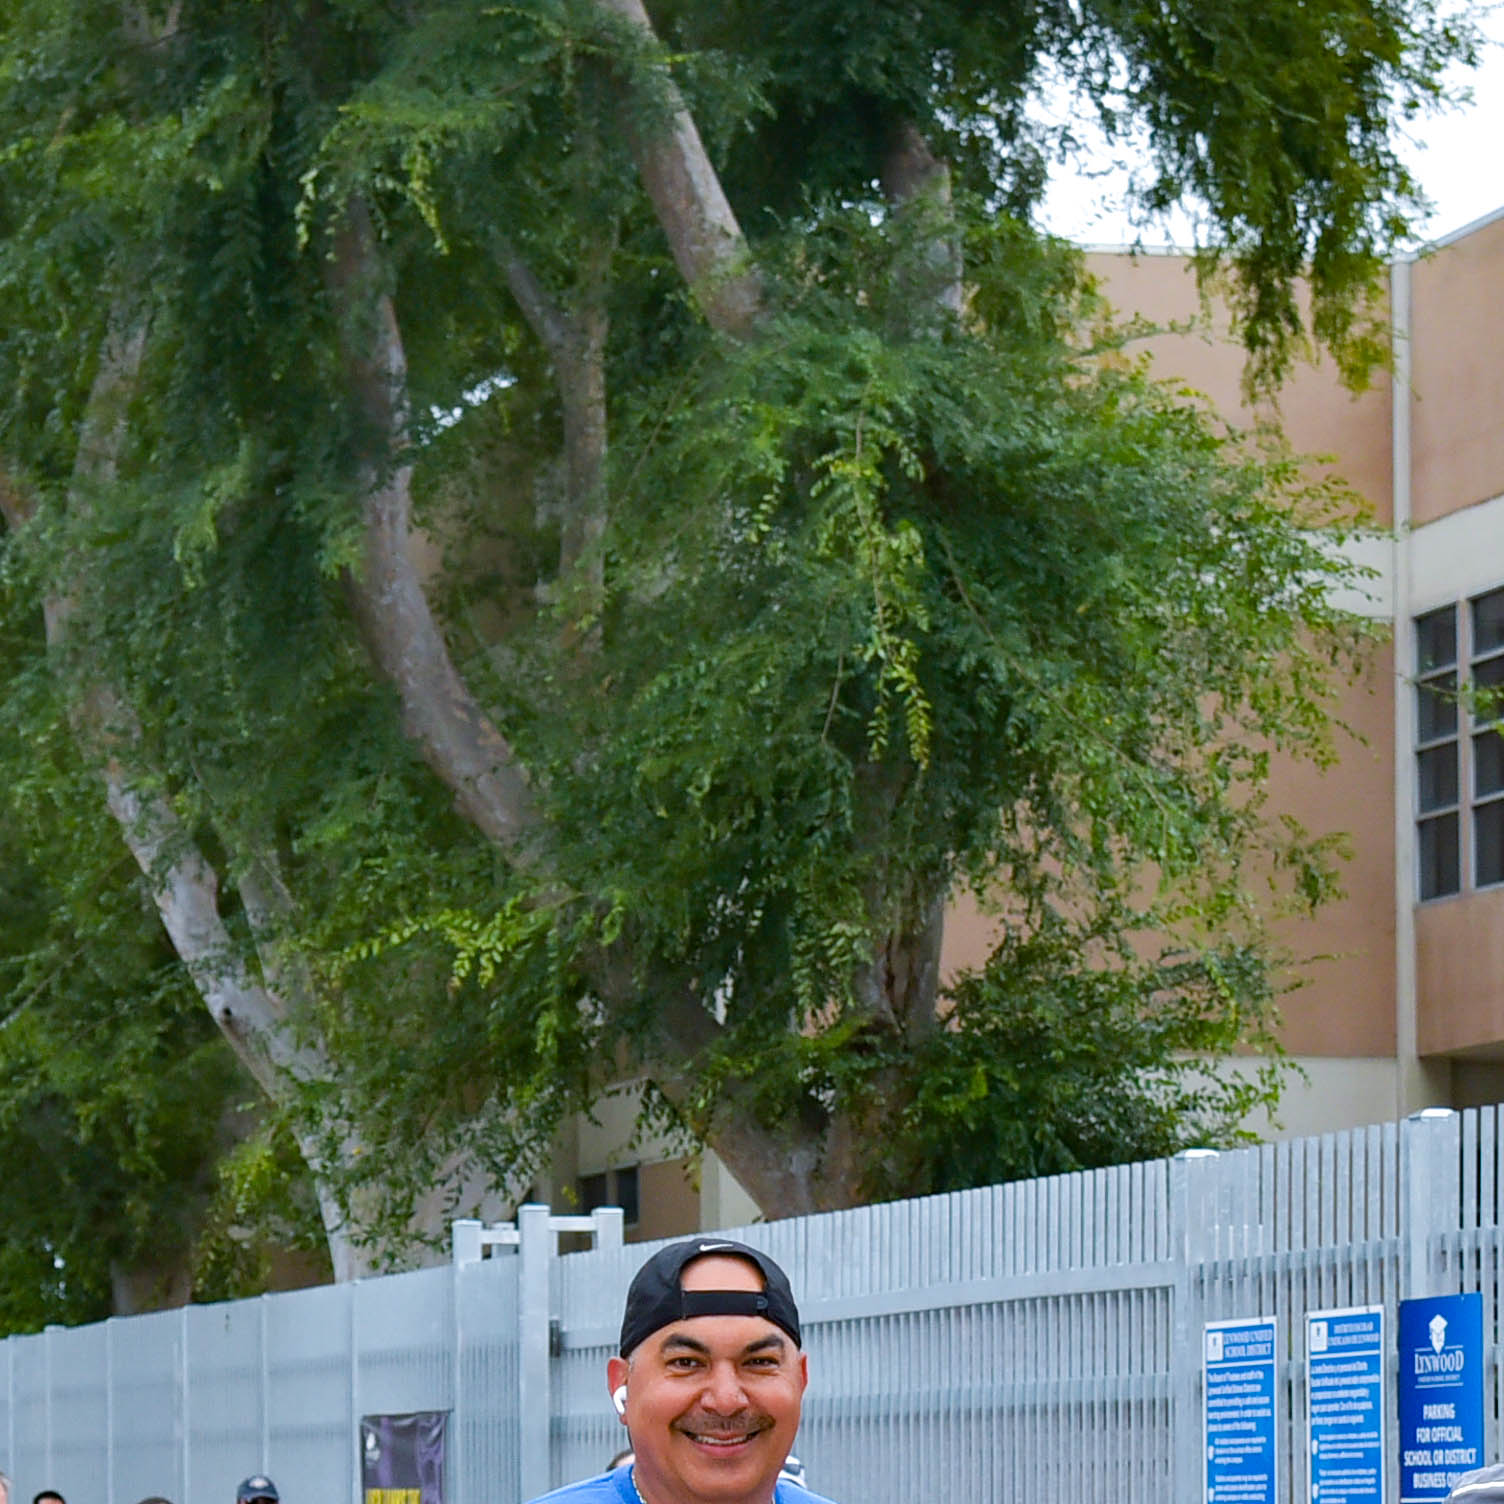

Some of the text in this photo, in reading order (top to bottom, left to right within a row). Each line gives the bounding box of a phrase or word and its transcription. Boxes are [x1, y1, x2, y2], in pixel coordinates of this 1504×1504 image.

[1414, 1350, 1465, 1375] LYNWOOD
[1422, 1402, 1456, 1420] PARKING
[1416, 1425, 1464, 1444] FOR OFFICIAL
[1404, 1447, 1477, 1467] SCHOOL OR DISTRICT
[1413, 1471, 1447, 1489] BUSINESS
